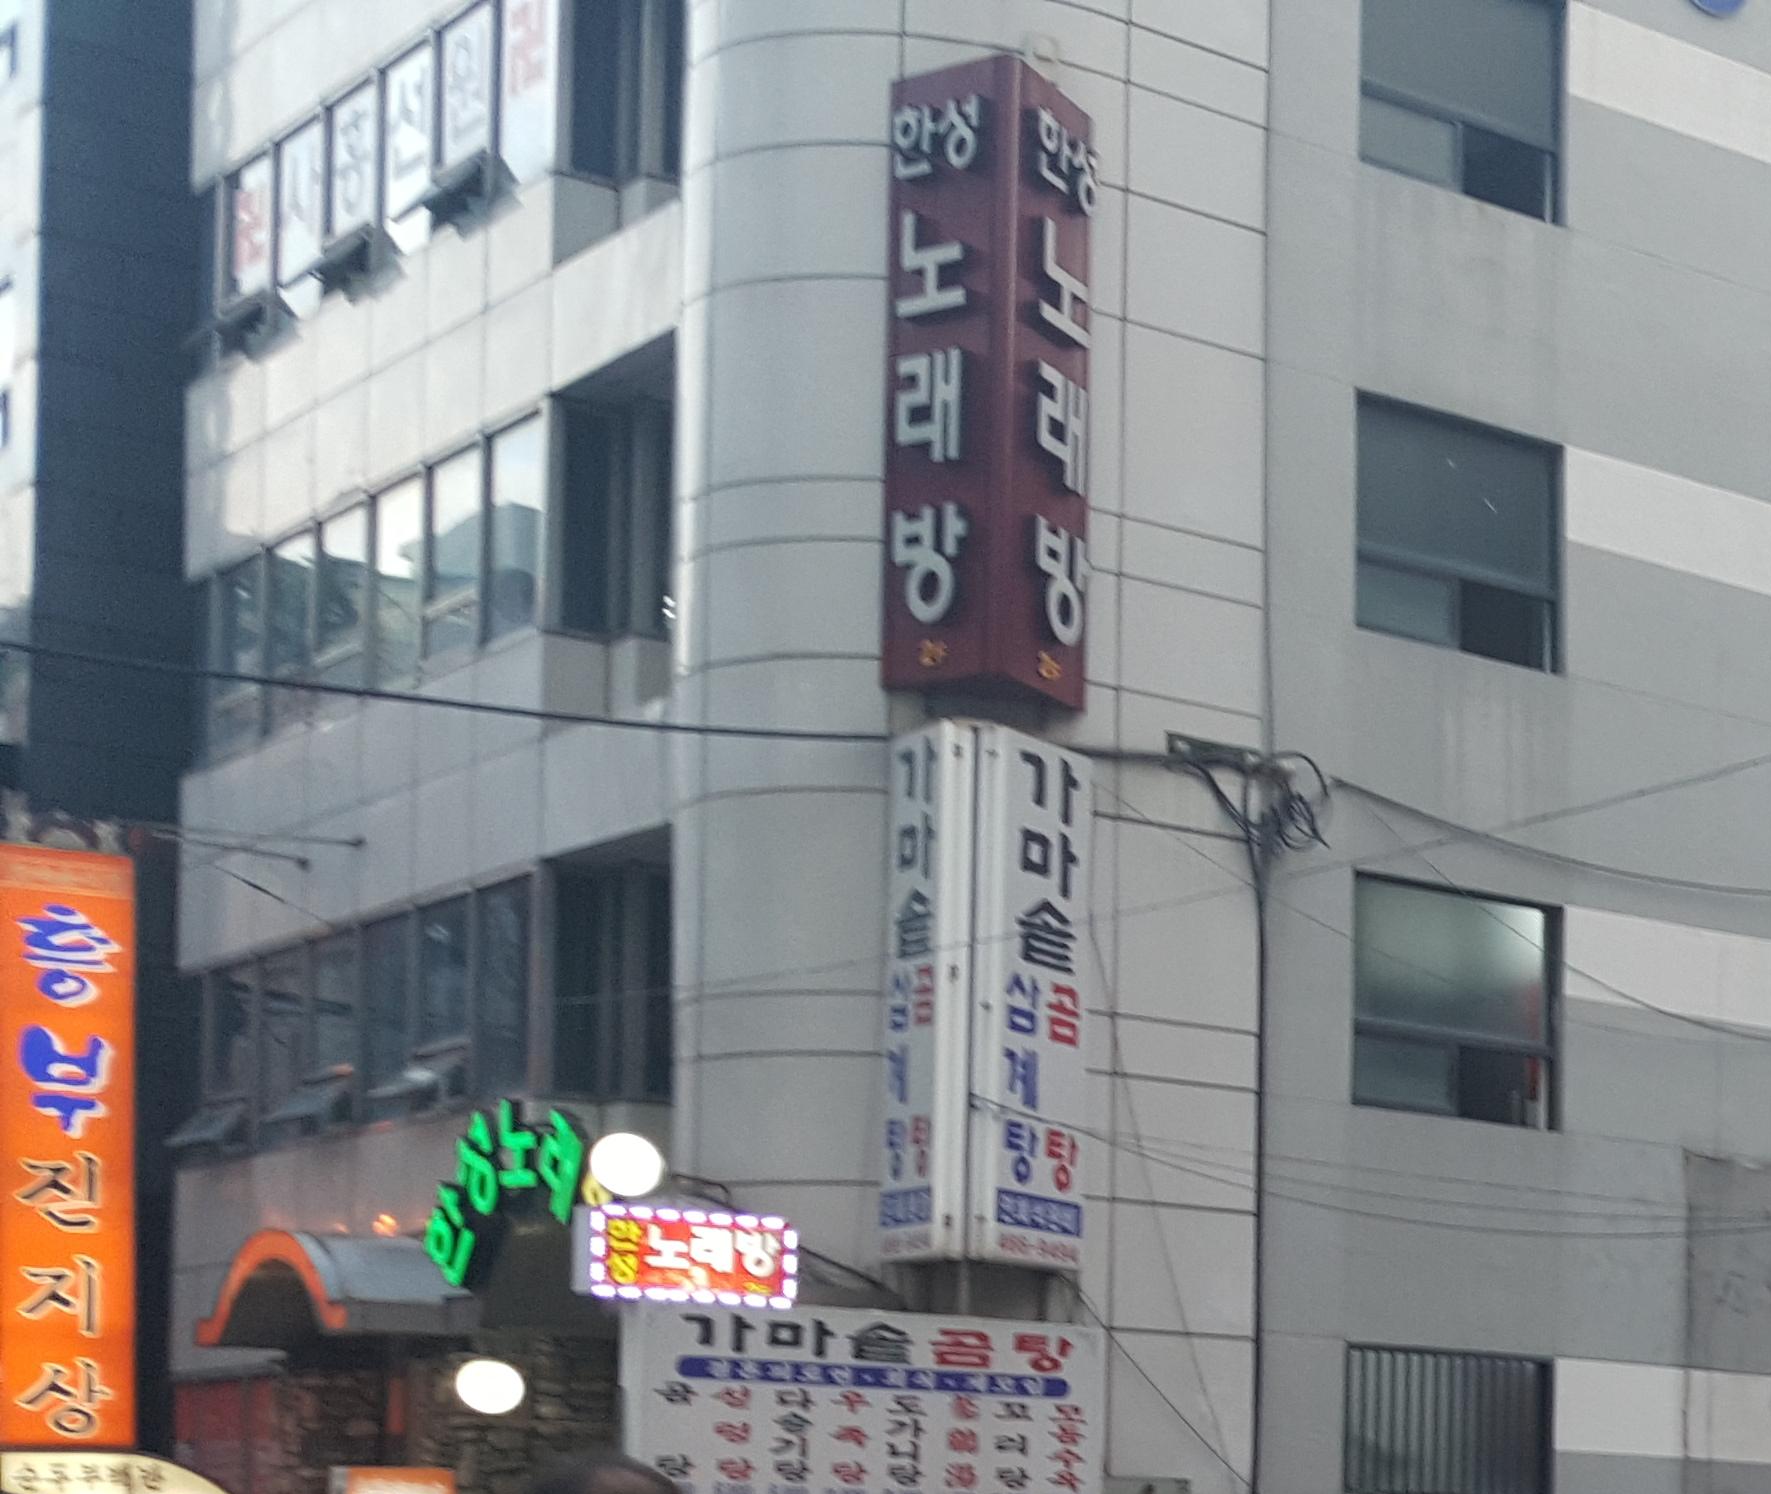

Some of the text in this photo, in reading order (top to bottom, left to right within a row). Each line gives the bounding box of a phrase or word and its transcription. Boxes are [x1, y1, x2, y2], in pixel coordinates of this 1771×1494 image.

[889, 94, 980, 622] 한성 노래방
[1033, 105, 1097, 645] 한성 노래방
[892, 734, 938, 963] 가마솥
[1014, 748, 1080, 976] 가마솥
[1003, 971, 1041, 1187] 삼계탕
[15, 1152, 115, 1440] 진지상
[645, 1221, 782, 1280] 노래방
[681, 1311, 1075, 1375] 가마솥 곰탕
